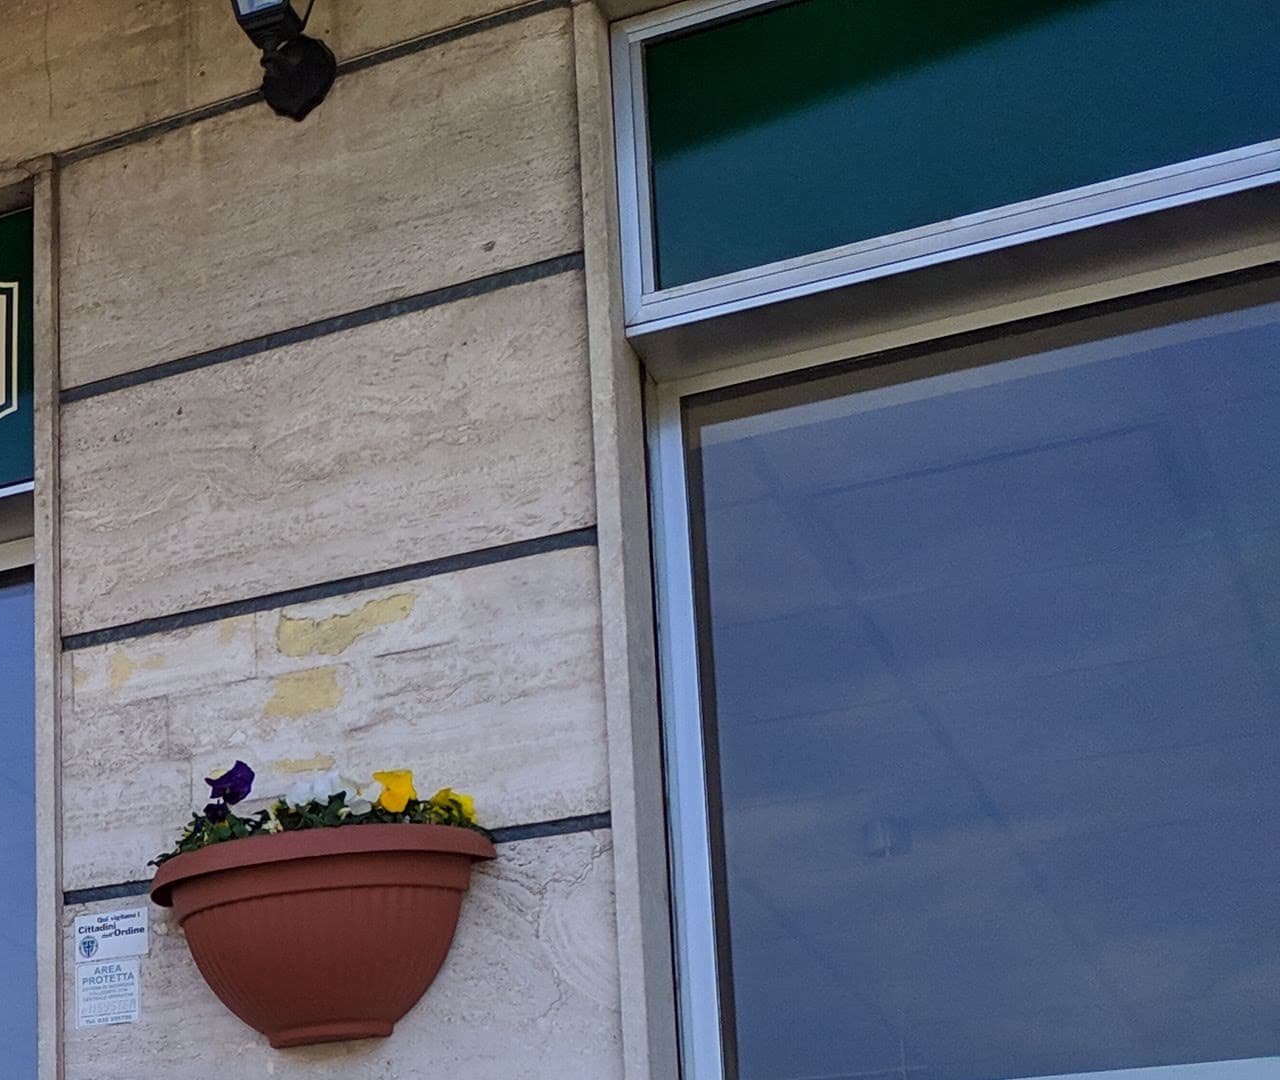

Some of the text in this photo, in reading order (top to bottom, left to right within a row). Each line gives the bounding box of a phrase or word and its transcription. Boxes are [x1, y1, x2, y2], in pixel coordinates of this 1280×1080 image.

[78, 921, 117, 935] Cittadini
[94, 964, 122, 975] AREA
[82, 971, 135, 985] PROTETTA
